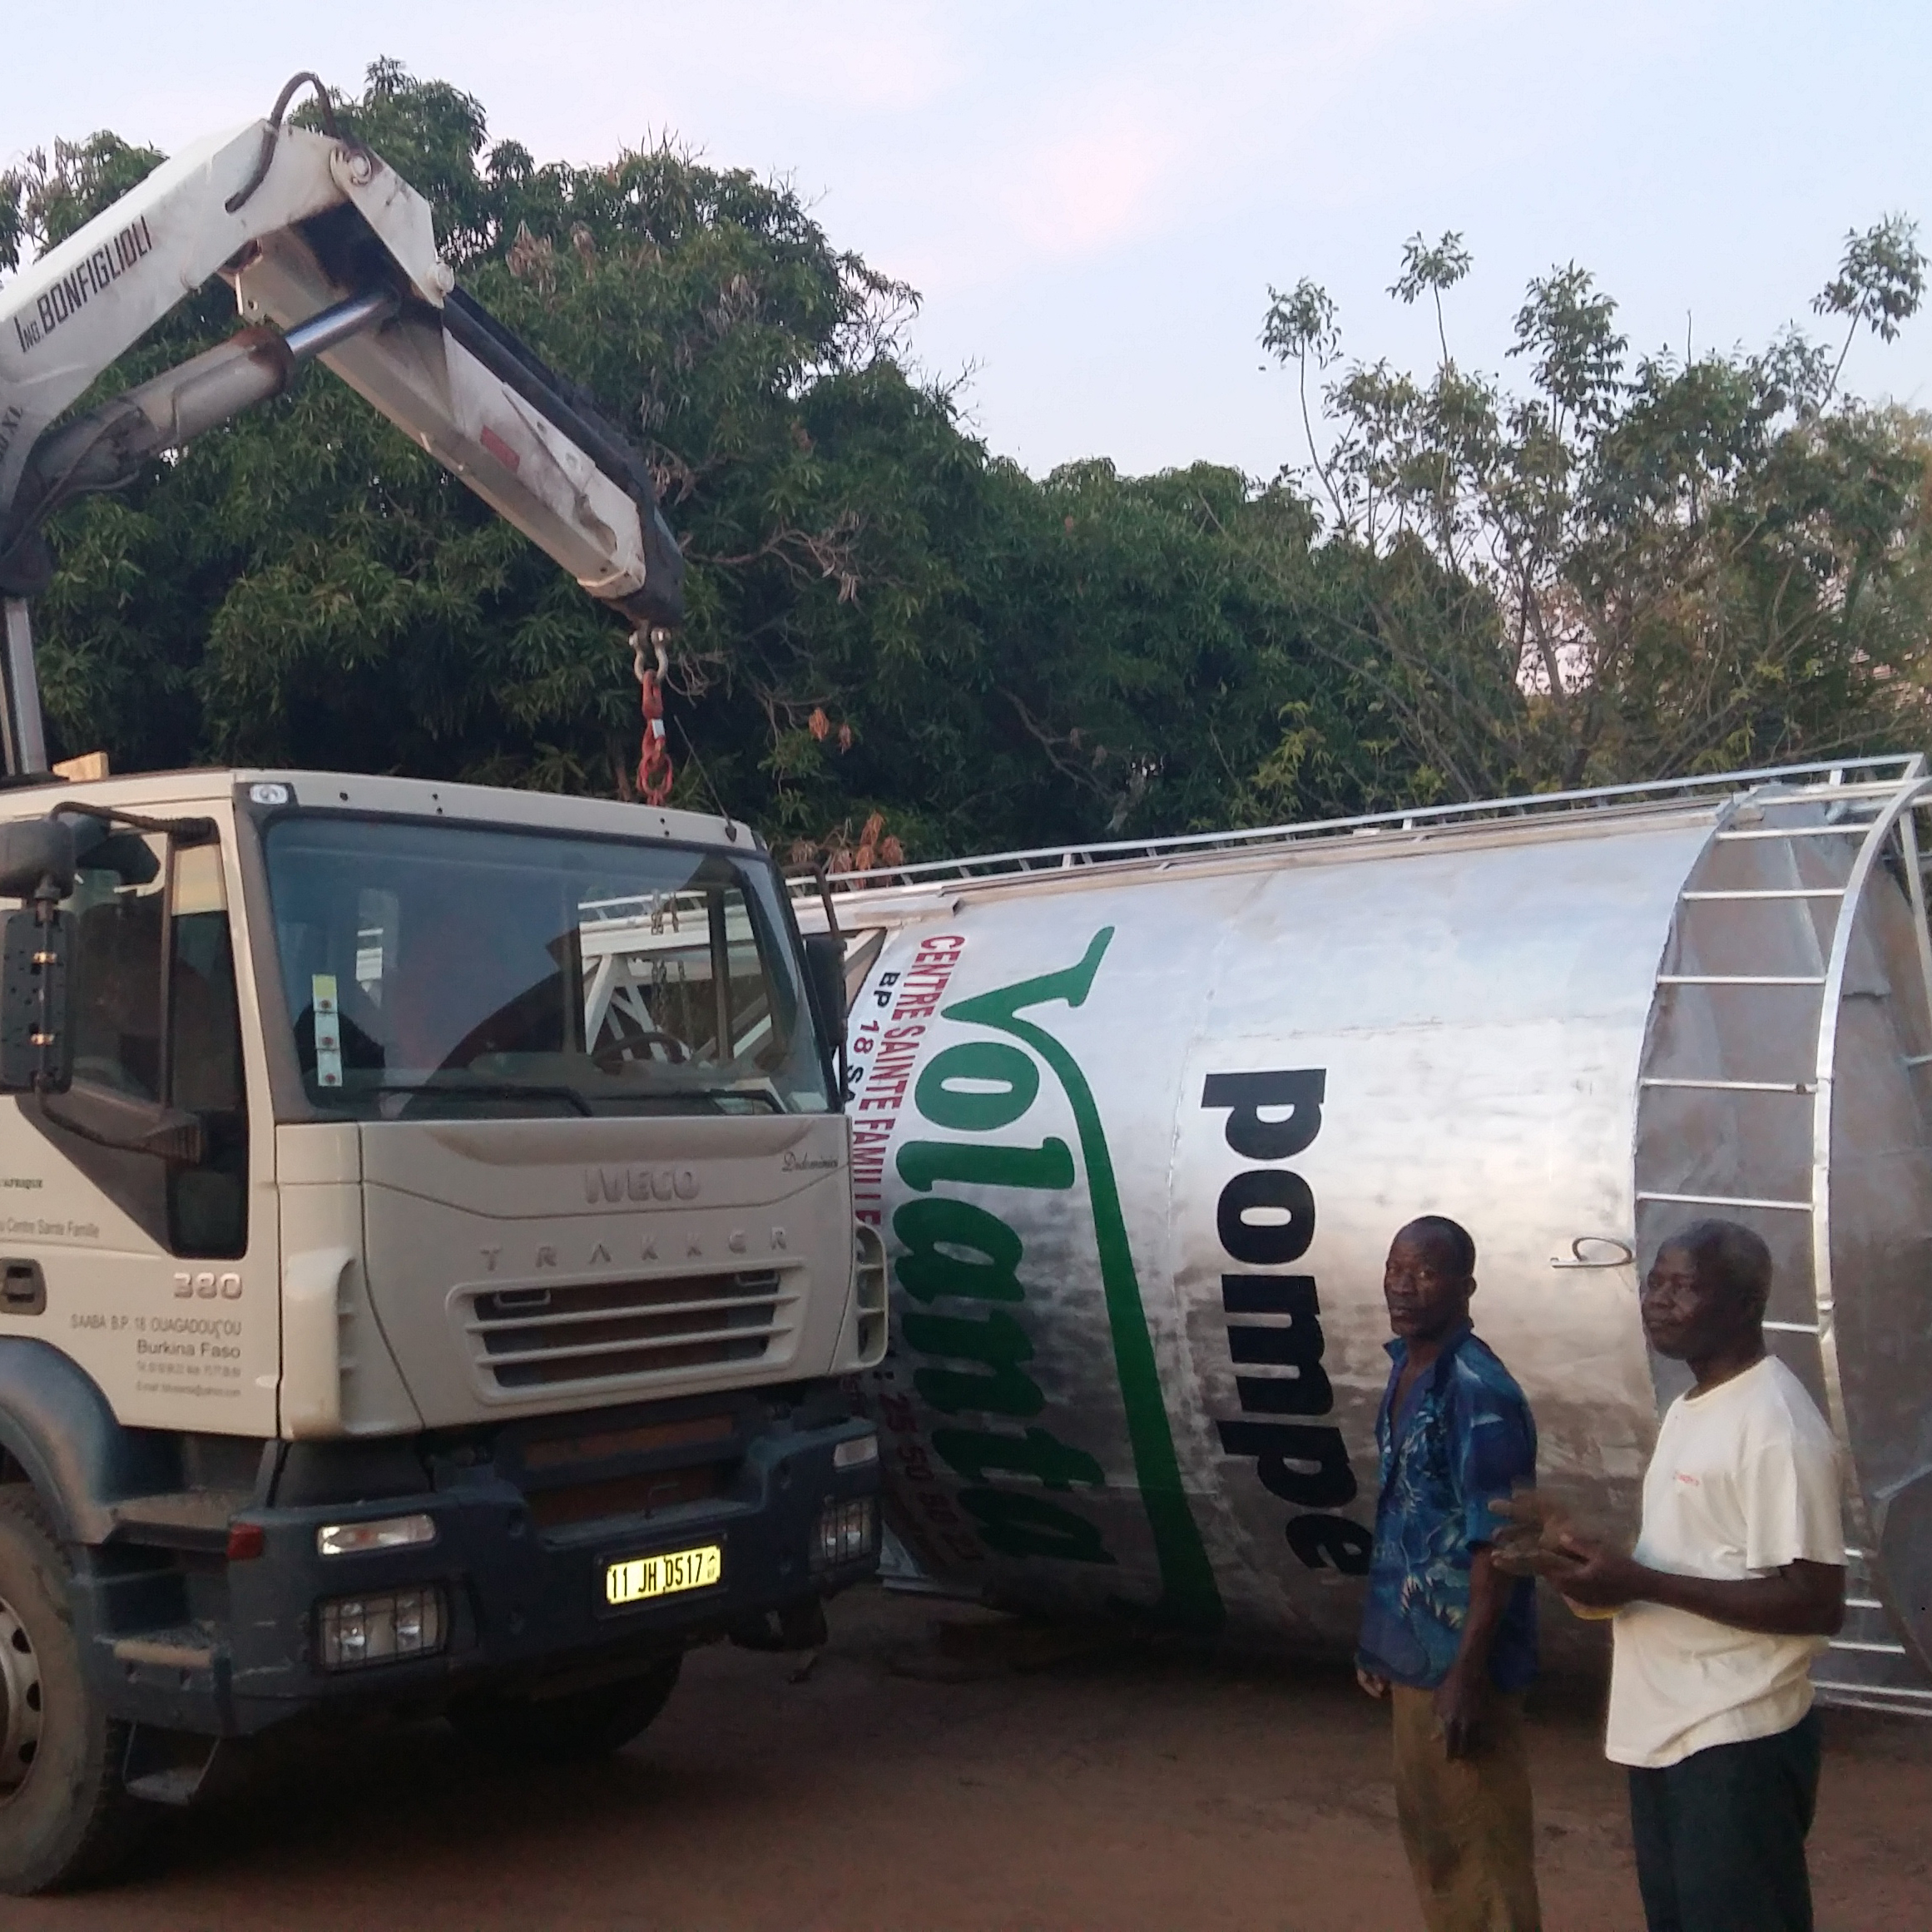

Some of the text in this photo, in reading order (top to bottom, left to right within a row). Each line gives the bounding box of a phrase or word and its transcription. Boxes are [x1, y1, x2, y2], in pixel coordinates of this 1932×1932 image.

[37, 215, 152, 335] BONFIGLIOLI
[874, 971, 901, 1008] BP
[892, 935, 965, 1021] CENTRE
[853, 1019, 879, 1055] 18
[859, 1024, 926, 1111] SAINTE
[585, 1168, 701, 1203] IVECO
[480, 1226, 788, 1271] TRAKKER
[173, 1272, 243, 1300] 380
[893, 925, 1228, 1631] Volanta
[1201, 1068, 1374, 1578] pompe
[136, 1339, 240, 1359] Burkina Faso
[612, 1553, 703, 1598] 11 JH 0517
